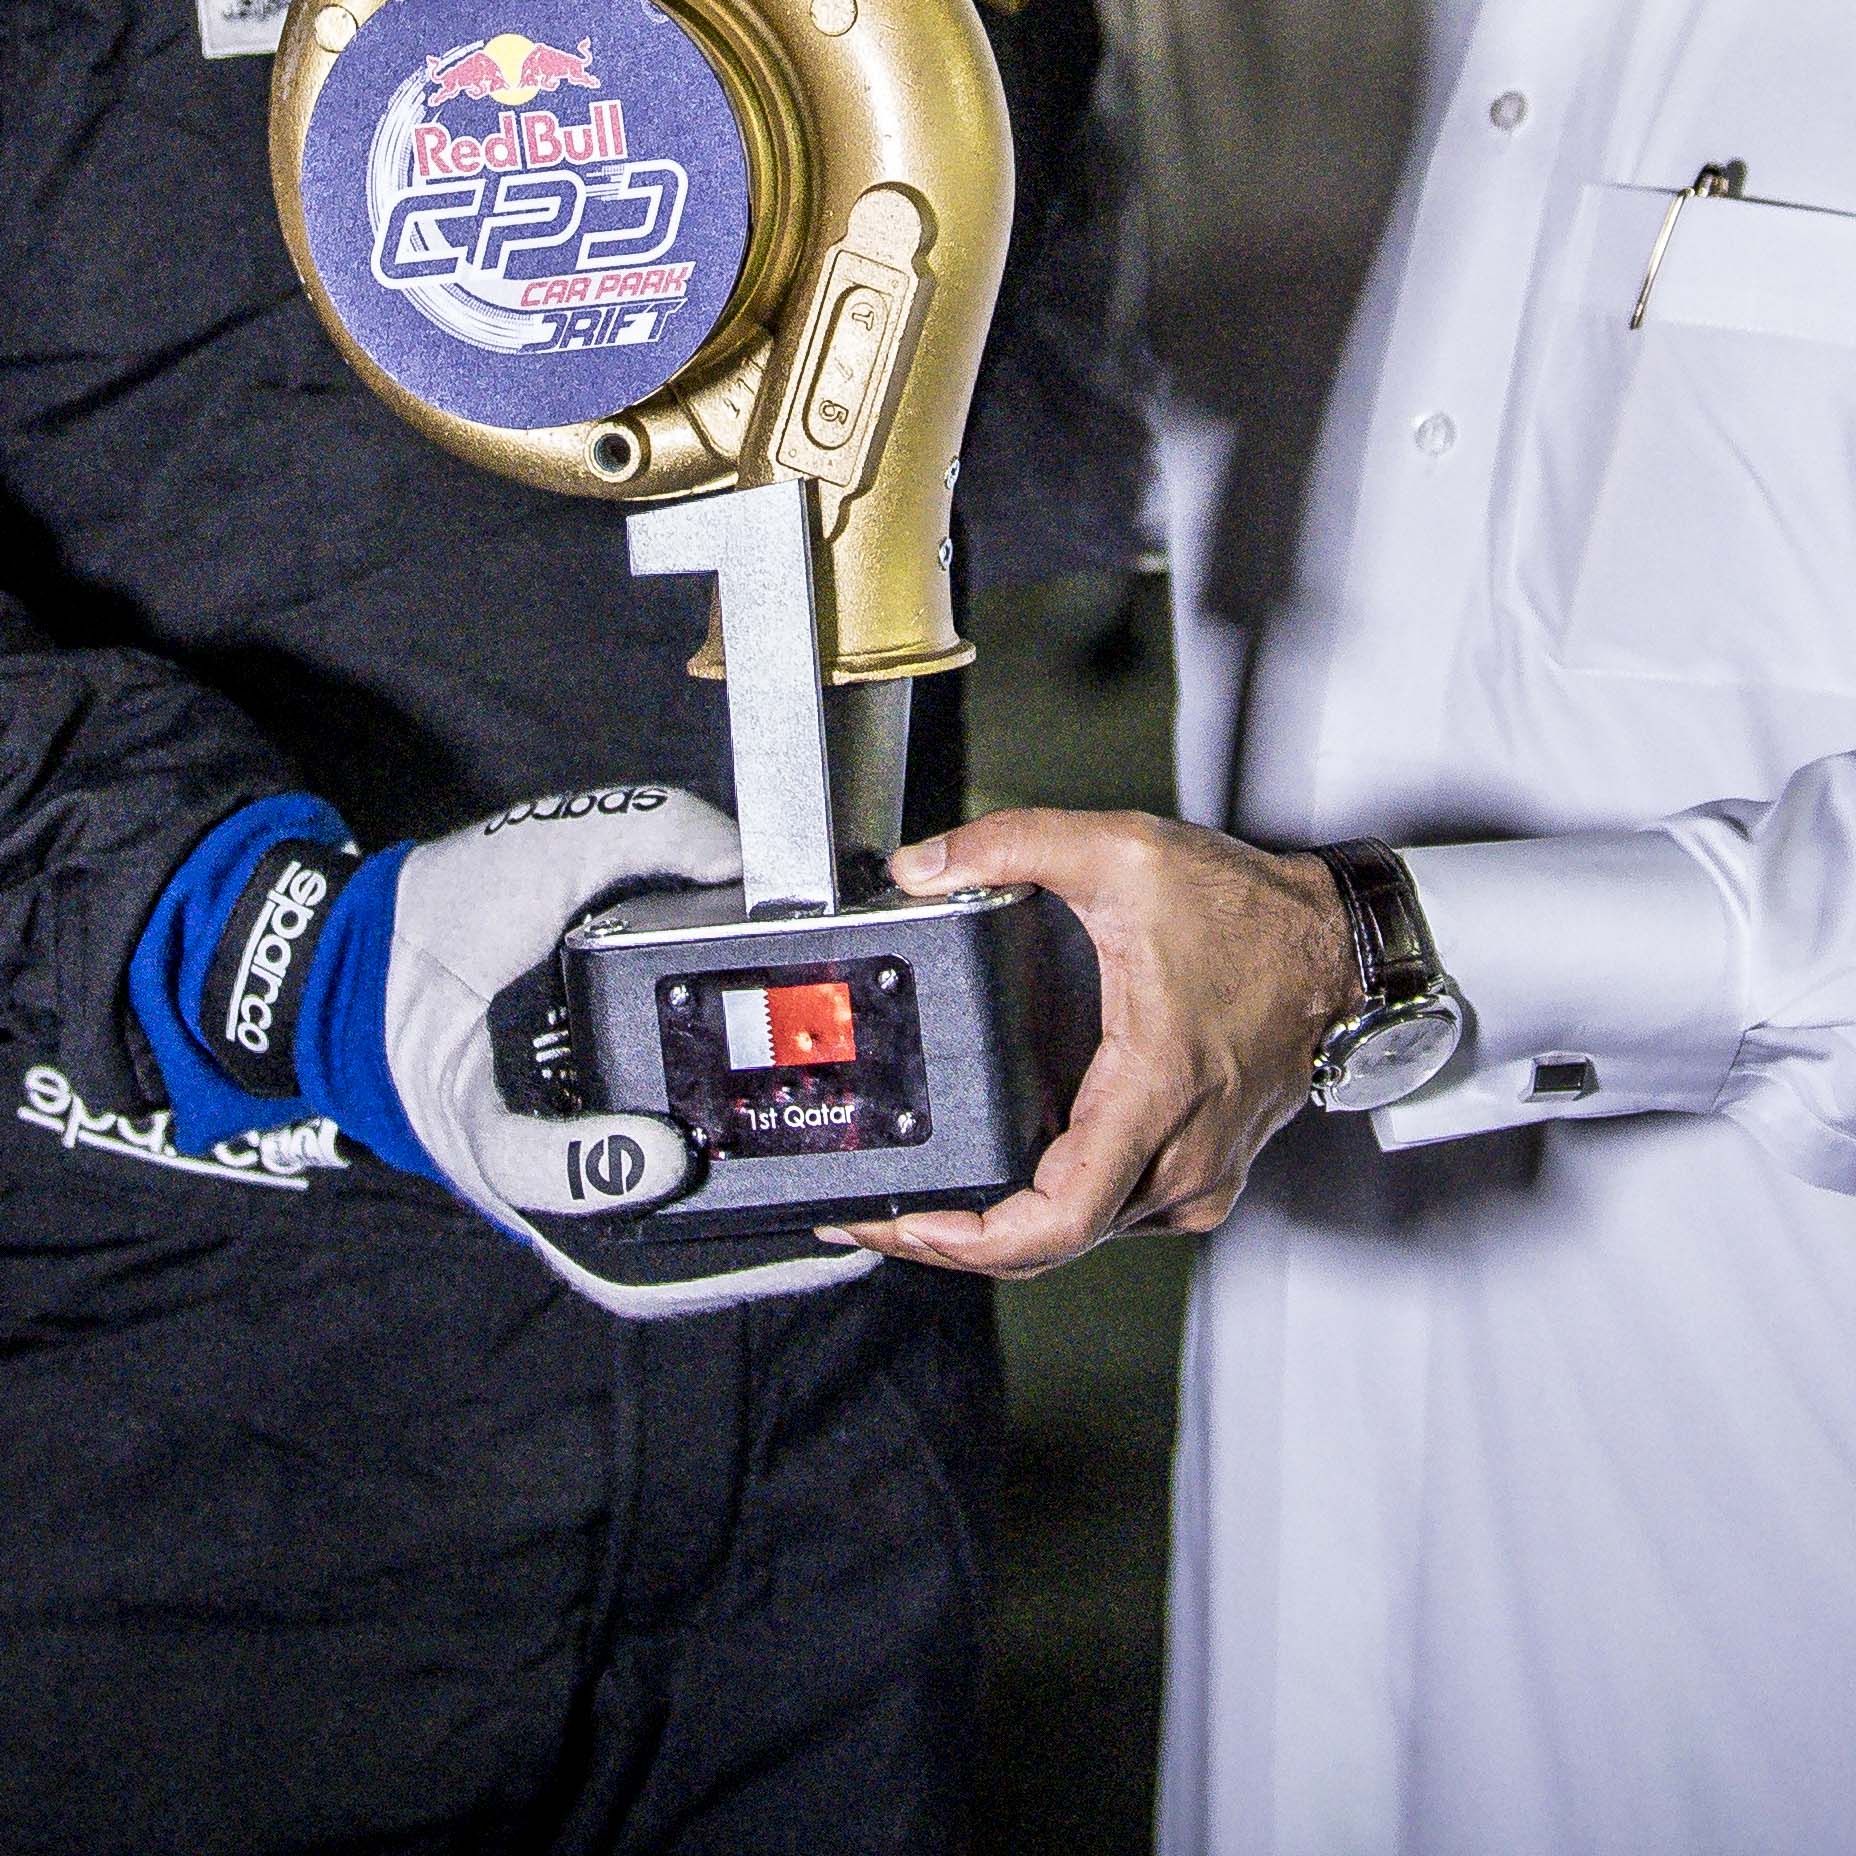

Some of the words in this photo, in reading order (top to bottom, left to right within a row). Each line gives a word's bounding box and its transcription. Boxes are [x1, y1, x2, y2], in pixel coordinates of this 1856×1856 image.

[413, 114, 519, 178] Red
[524, 102, 626, 166] Bull
[520, 280, 590, 308] CAR
[595, 269, 688, 299] PARK
[520, 300, 688, 354] DRIFT
[627, 478, 836, 917] 1
[230, 862, 327, 1054] sparco
[745, 1106, 778, 1131] 1st
[783, 1103, 856, 1129] Qatar
